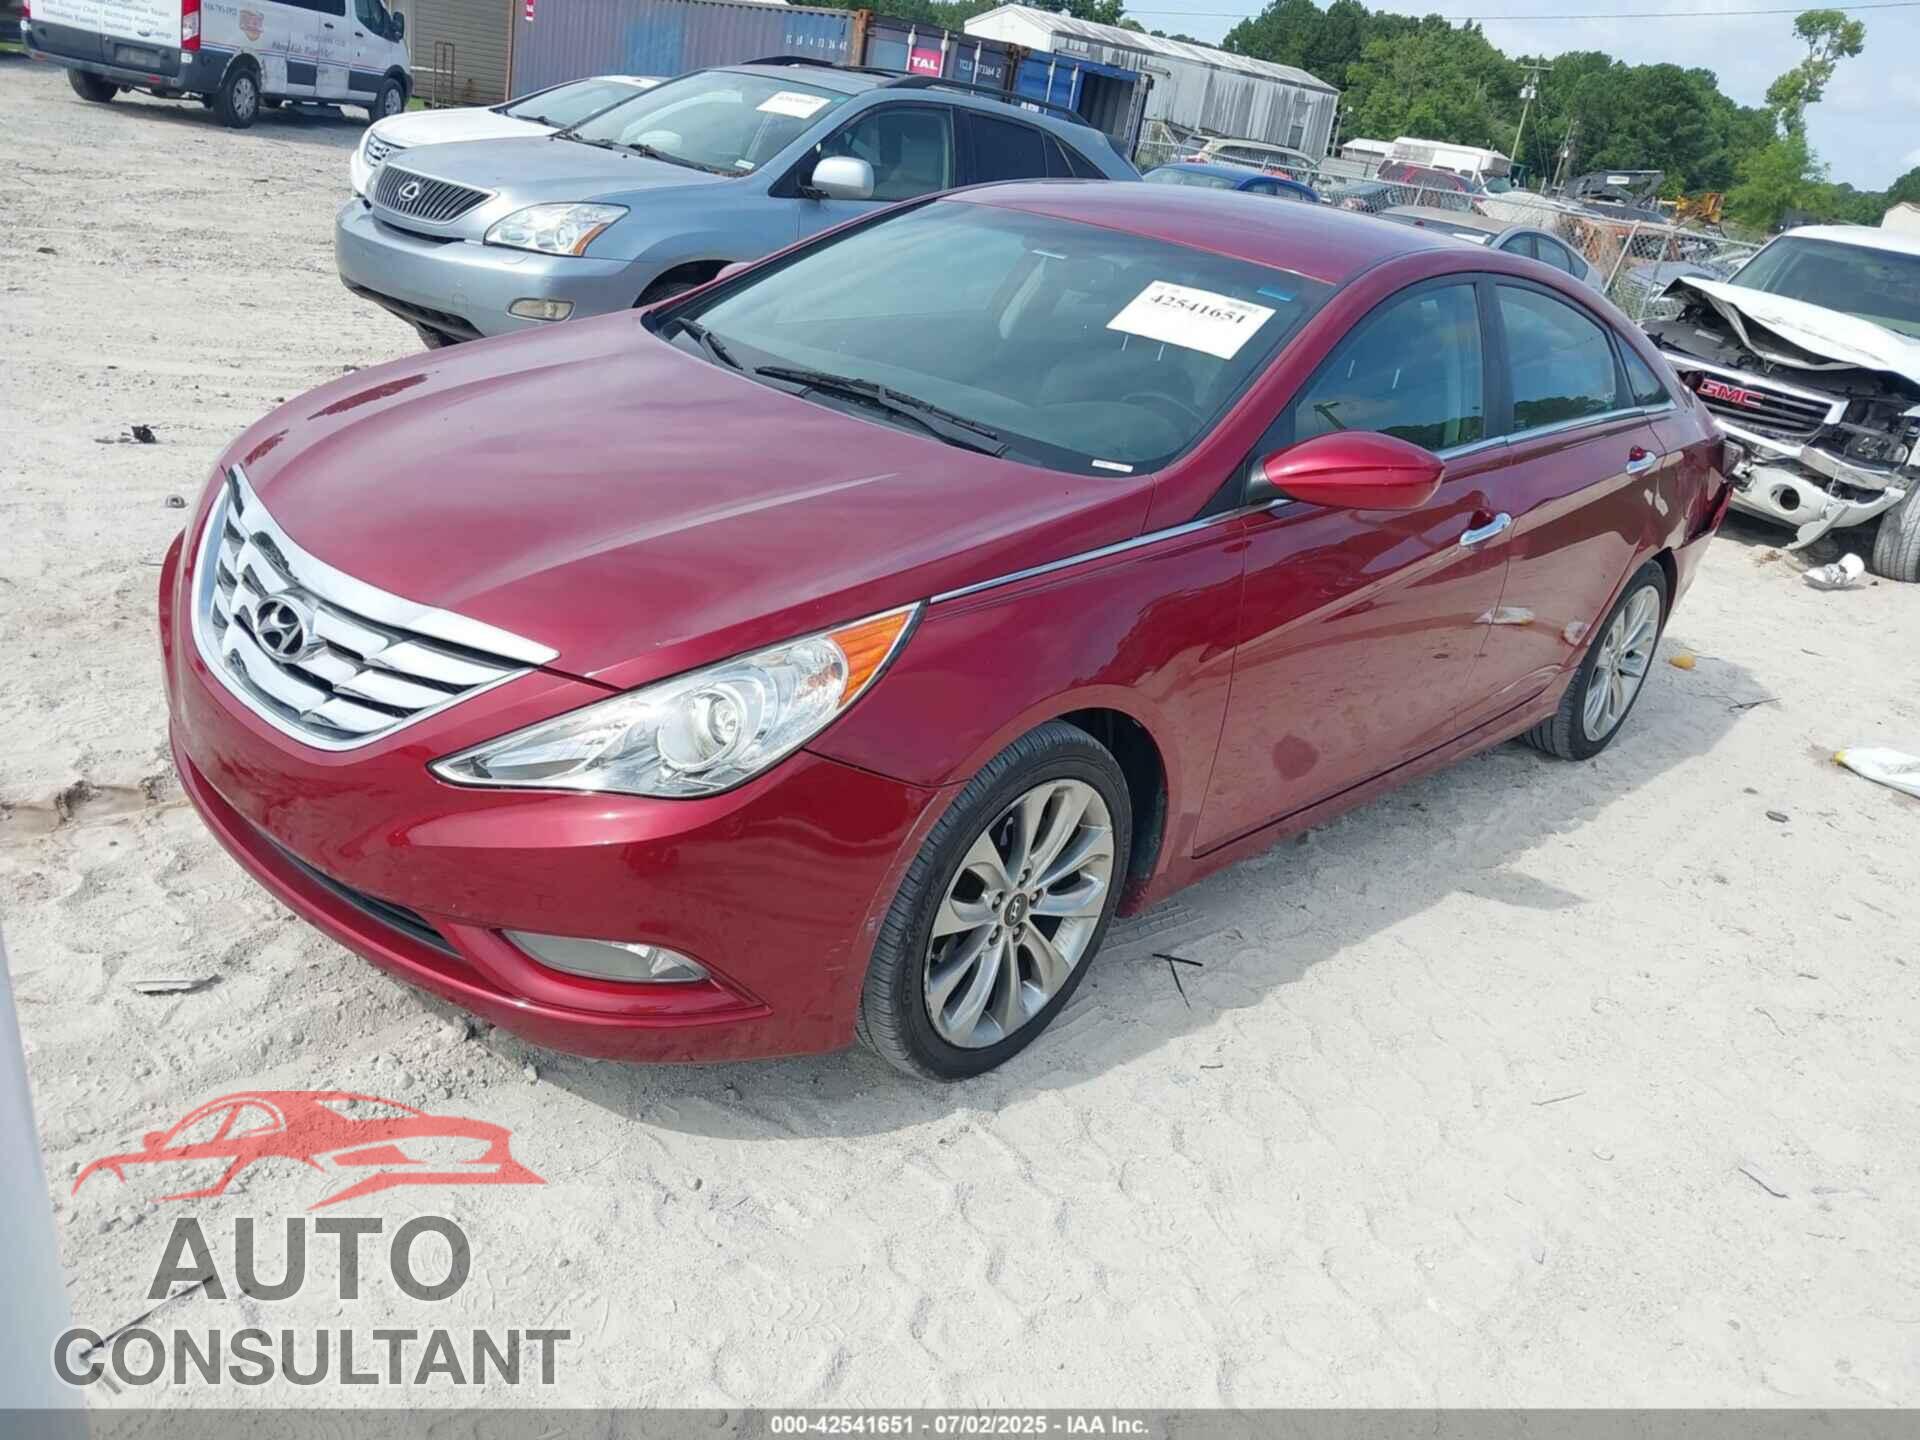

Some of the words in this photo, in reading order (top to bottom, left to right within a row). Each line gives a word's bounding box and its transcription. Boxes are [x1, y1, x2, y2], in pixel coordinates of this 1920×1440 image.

[911, 56, 938, 70] TAL
[1150, 294, 1246, 324] 42541651
[1697, 379, 1762, 409] GMC
